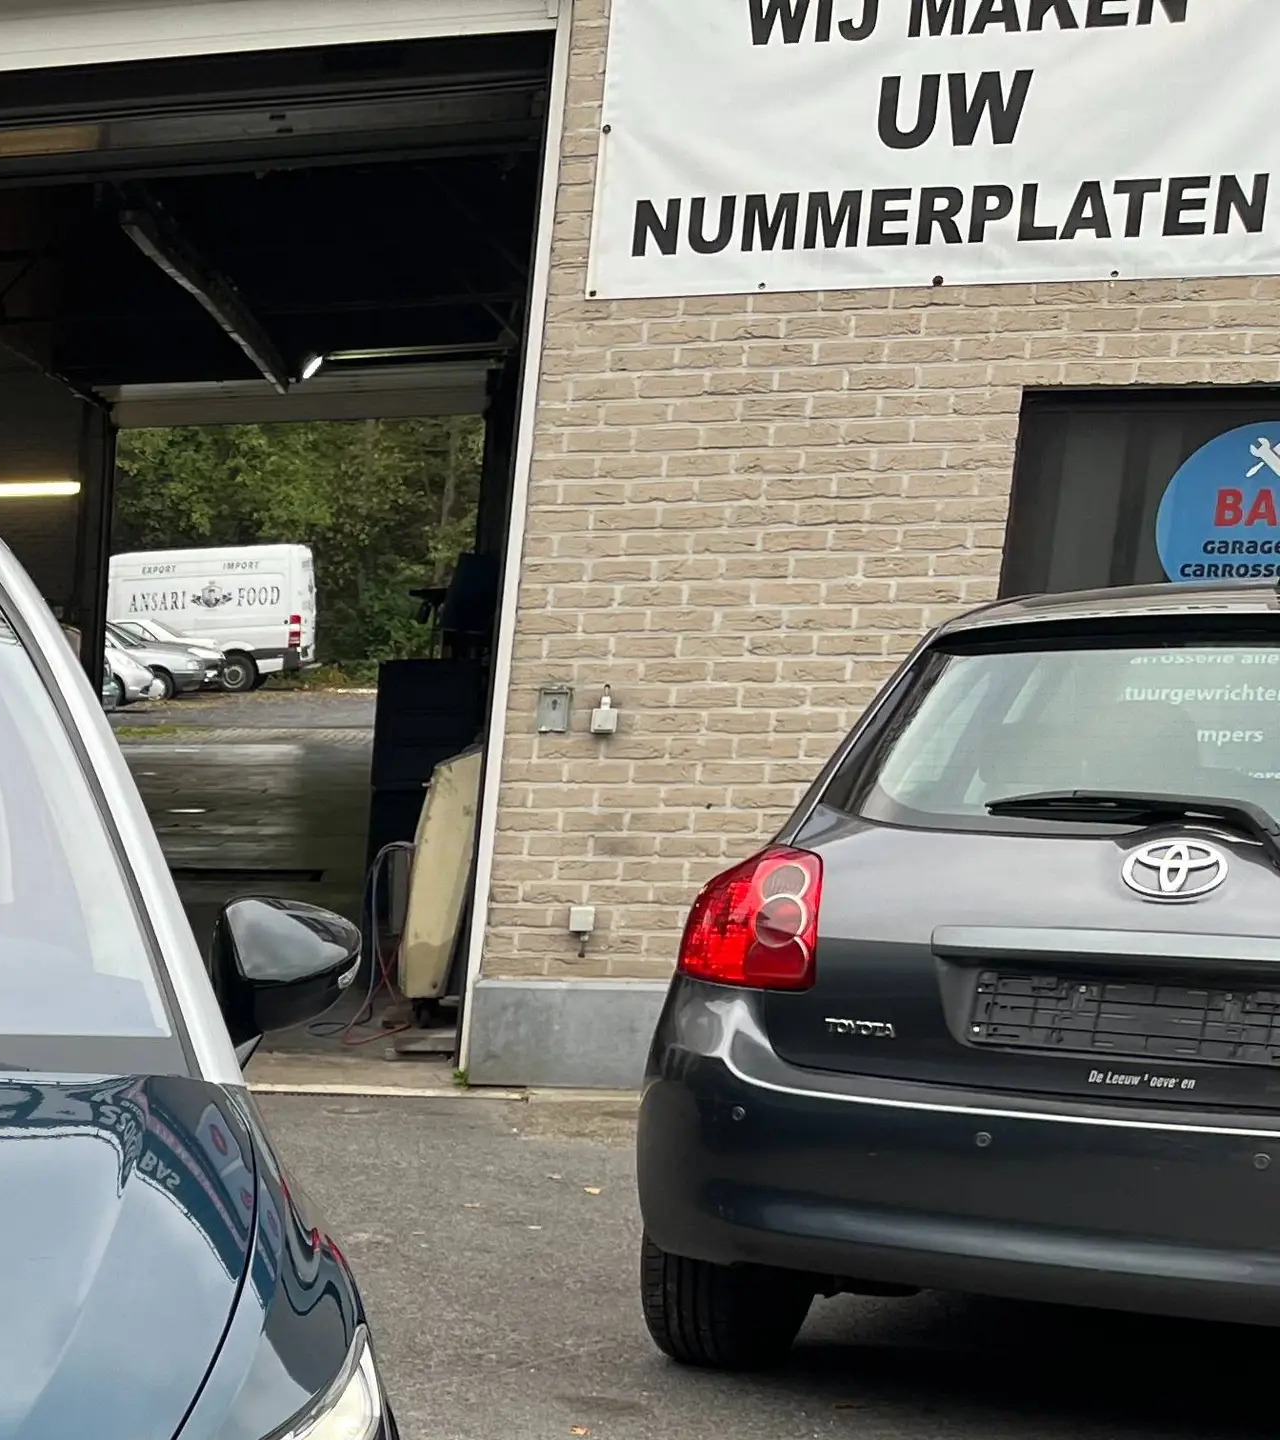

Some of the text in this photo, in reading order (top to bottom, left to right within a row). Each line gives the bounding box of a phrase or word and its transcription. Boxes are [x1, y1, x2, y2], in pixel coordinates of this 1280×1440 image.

[748, 0, 878, 46] WIJ
[877, 69, 1034, 150] UW
[631, 172, 1270, 257] NUMMERPLATEN
[1214, 488, 1279, 527] BA
[141, 560, 261, 576] EXPORT IMPORT
[128, 586, 281, 613] ANSARI FOOD
[1120, 683, 1280, 705] tuurgewrichte
[1088, 1069, 1104, 1083] De
[1105, 1071, 1141, 1086] Leeuw
